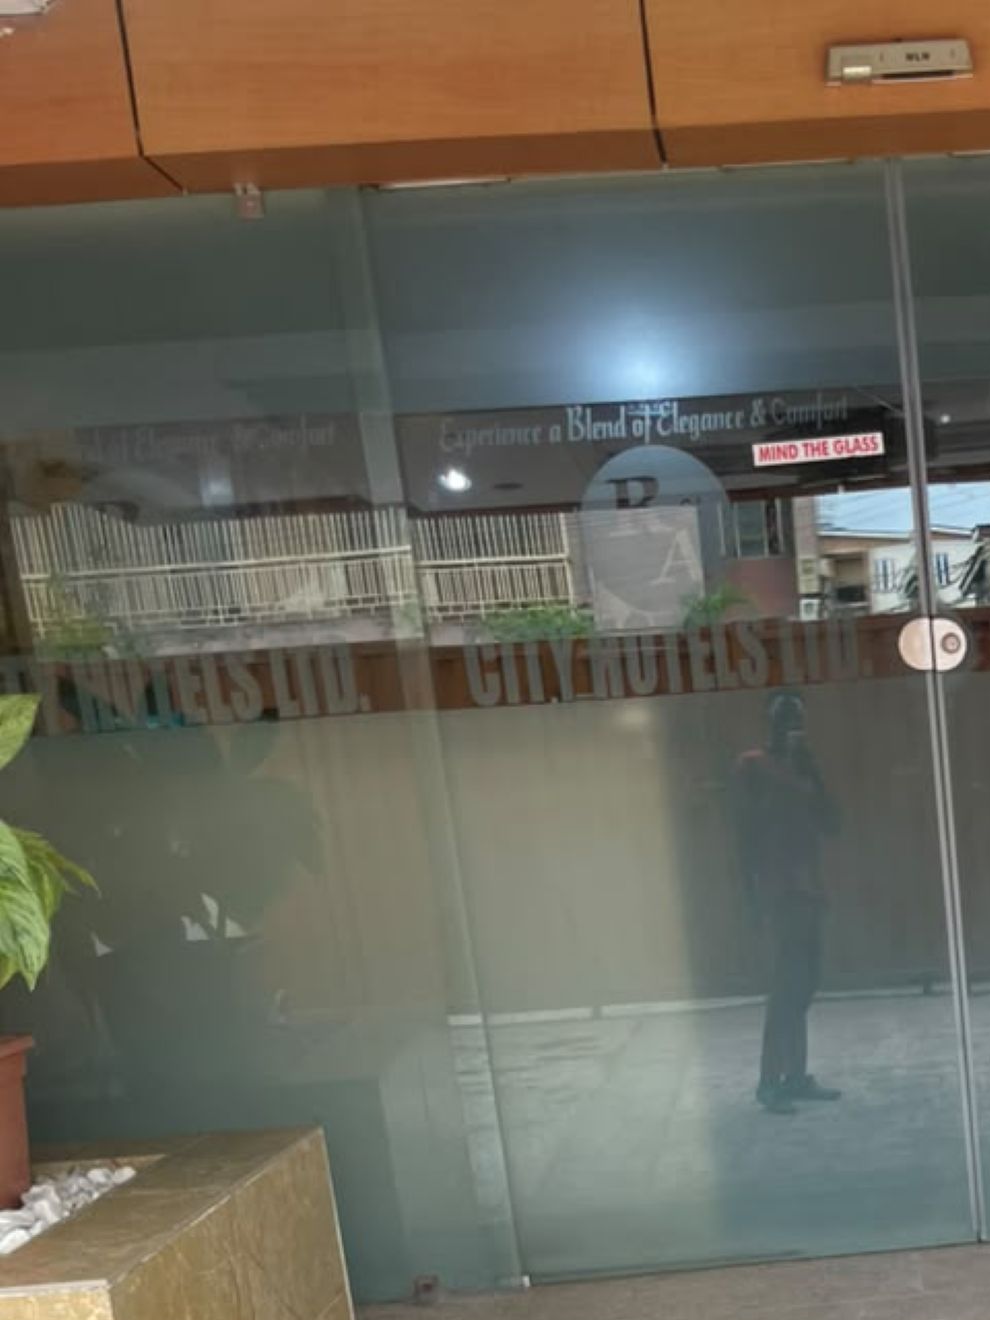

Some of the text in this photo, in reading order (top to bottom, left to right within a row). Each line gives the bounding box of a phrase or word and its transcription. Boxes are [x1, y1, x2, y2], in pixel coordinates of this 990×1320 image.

[439, 393, 848, 457] Experience a Blend of Elegance & Comfort
[758, 435, 880, 463] MIND THE GLASS
[464, 635, 578, 707] CITY
[590, 617, 770, 699] HOTELS
